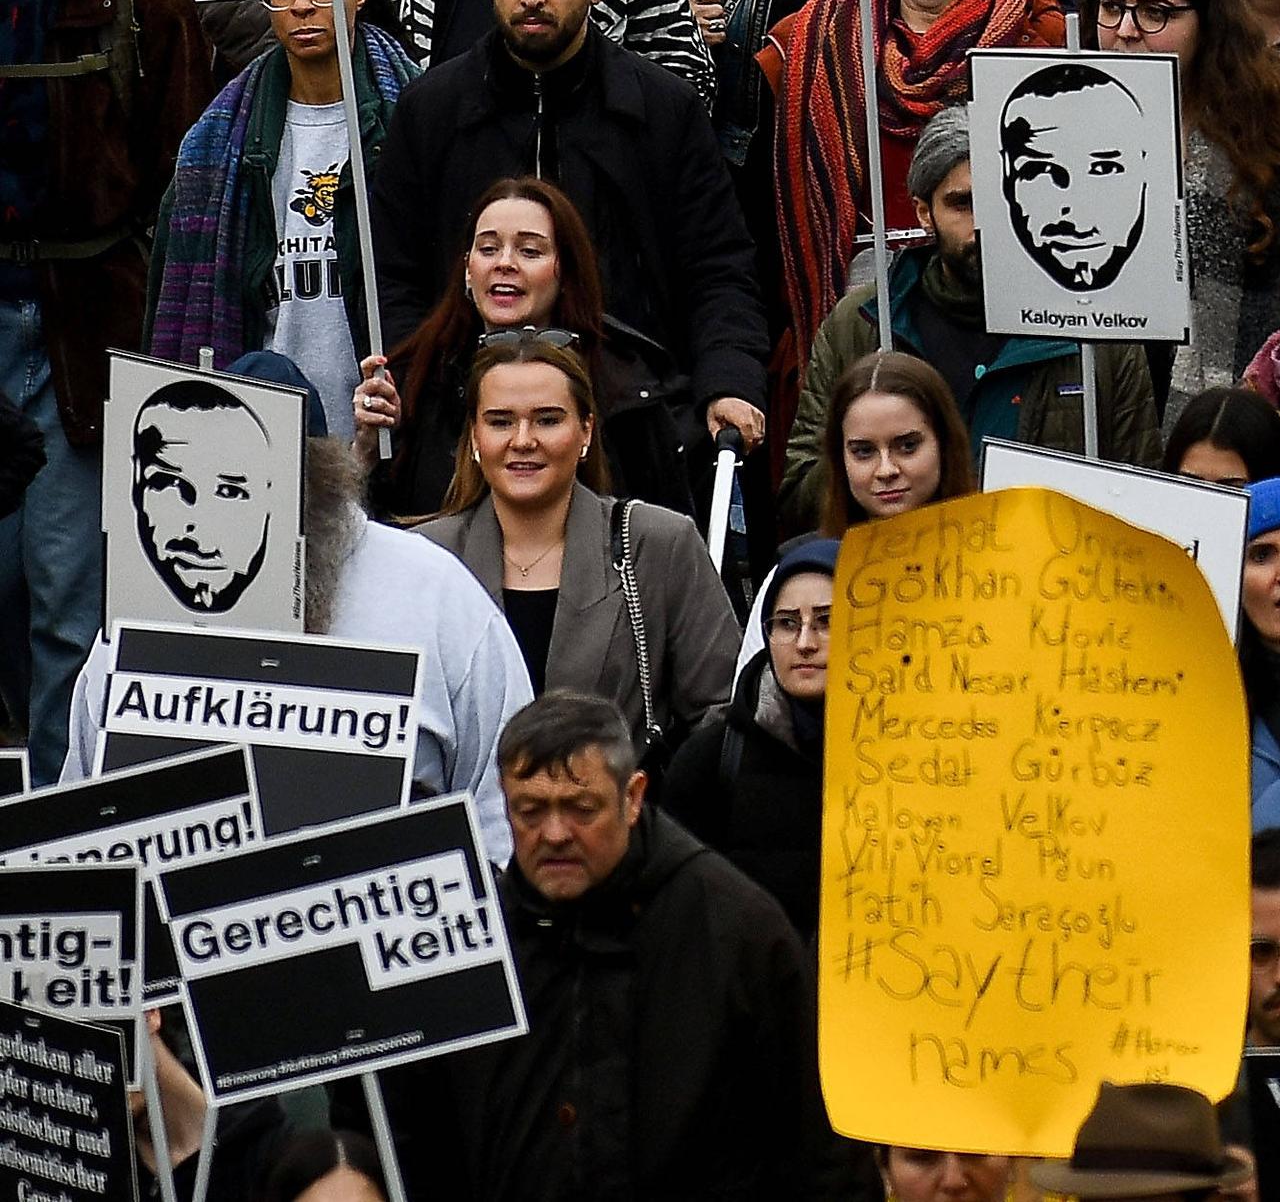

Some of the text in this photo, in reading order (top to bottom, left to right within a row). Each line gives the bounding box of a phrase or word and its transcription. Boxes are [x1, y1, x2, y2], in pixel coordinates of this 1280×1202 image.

[1020, 309, 1149, 331] Kaloyan Velkov
[115, 680, 410, 749] Aufklärung!
[182, 874, 463, 963] Gerechtig-
[376, 907, 495, 972] keit!
